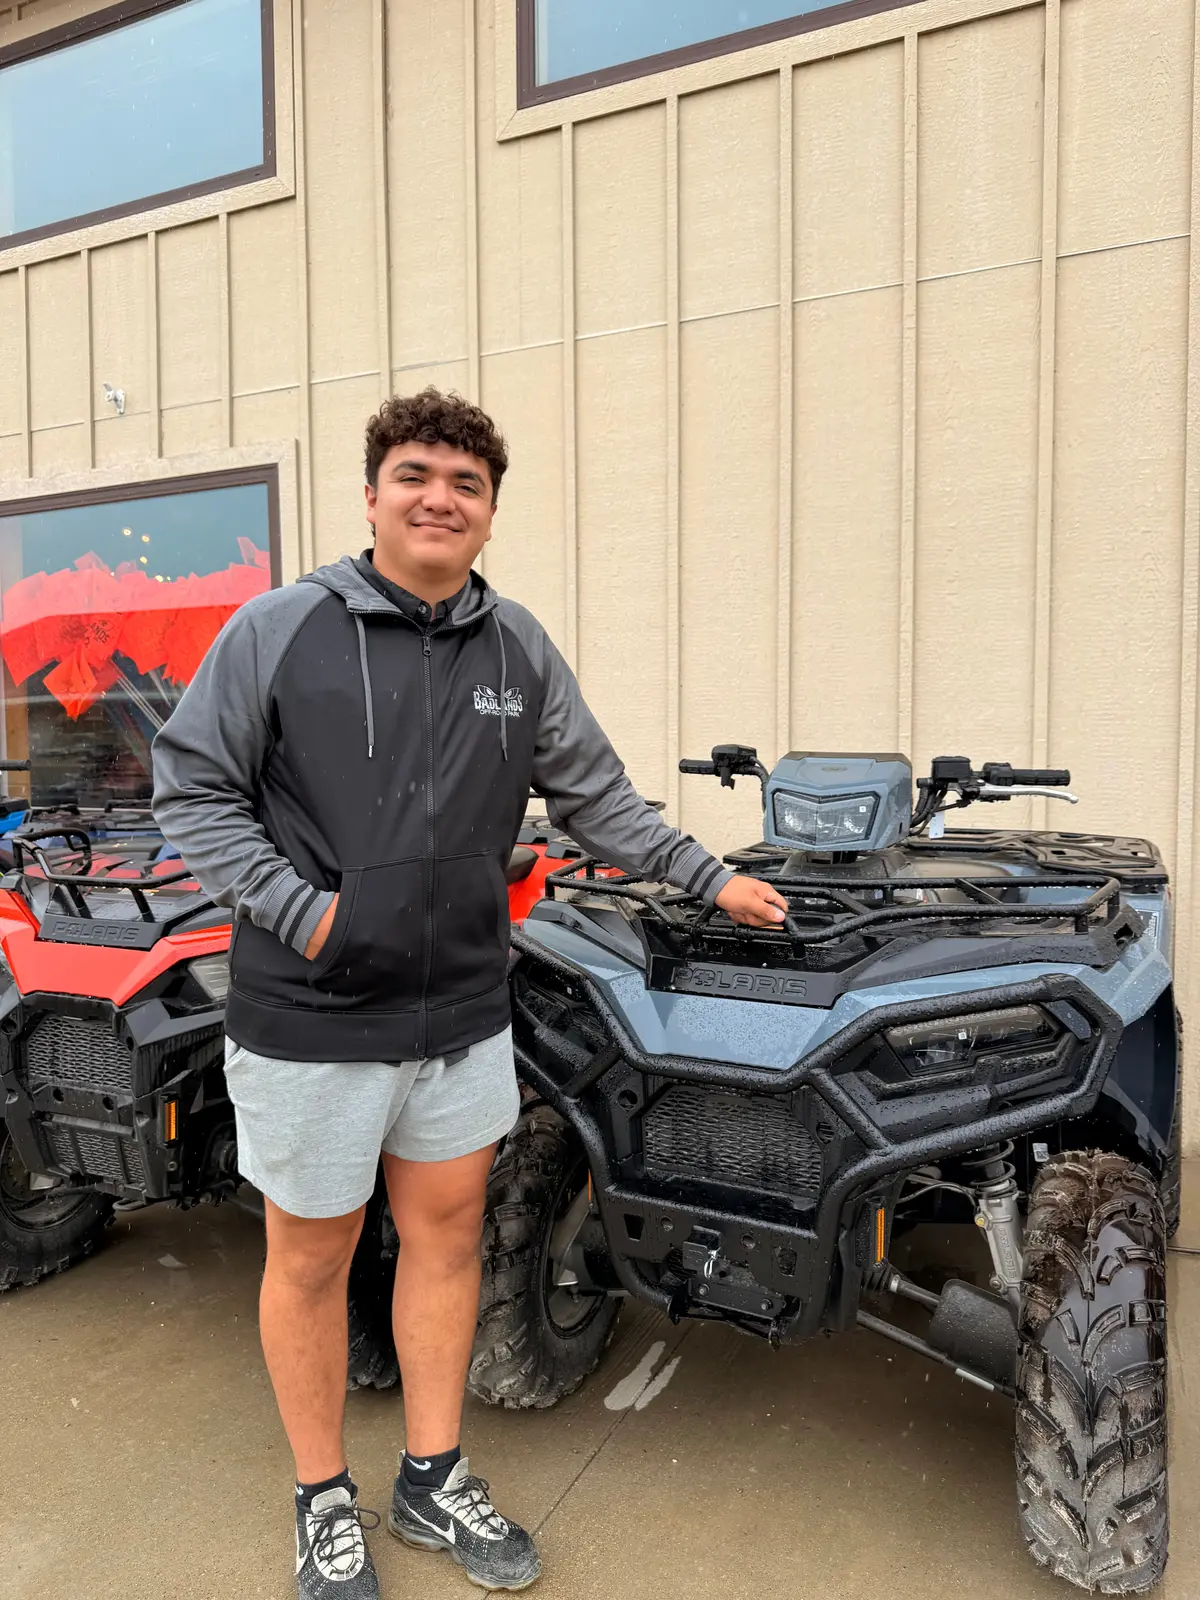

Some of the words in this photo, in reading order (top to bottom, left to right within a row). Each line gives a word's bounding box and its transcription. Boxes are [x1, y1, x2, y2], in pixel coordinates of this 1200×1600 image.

[473, 691, 523, 712] BADLNDS
[52, 921, 139, 942] POLARIS
[672, 967, 808, 997] POLARIS
